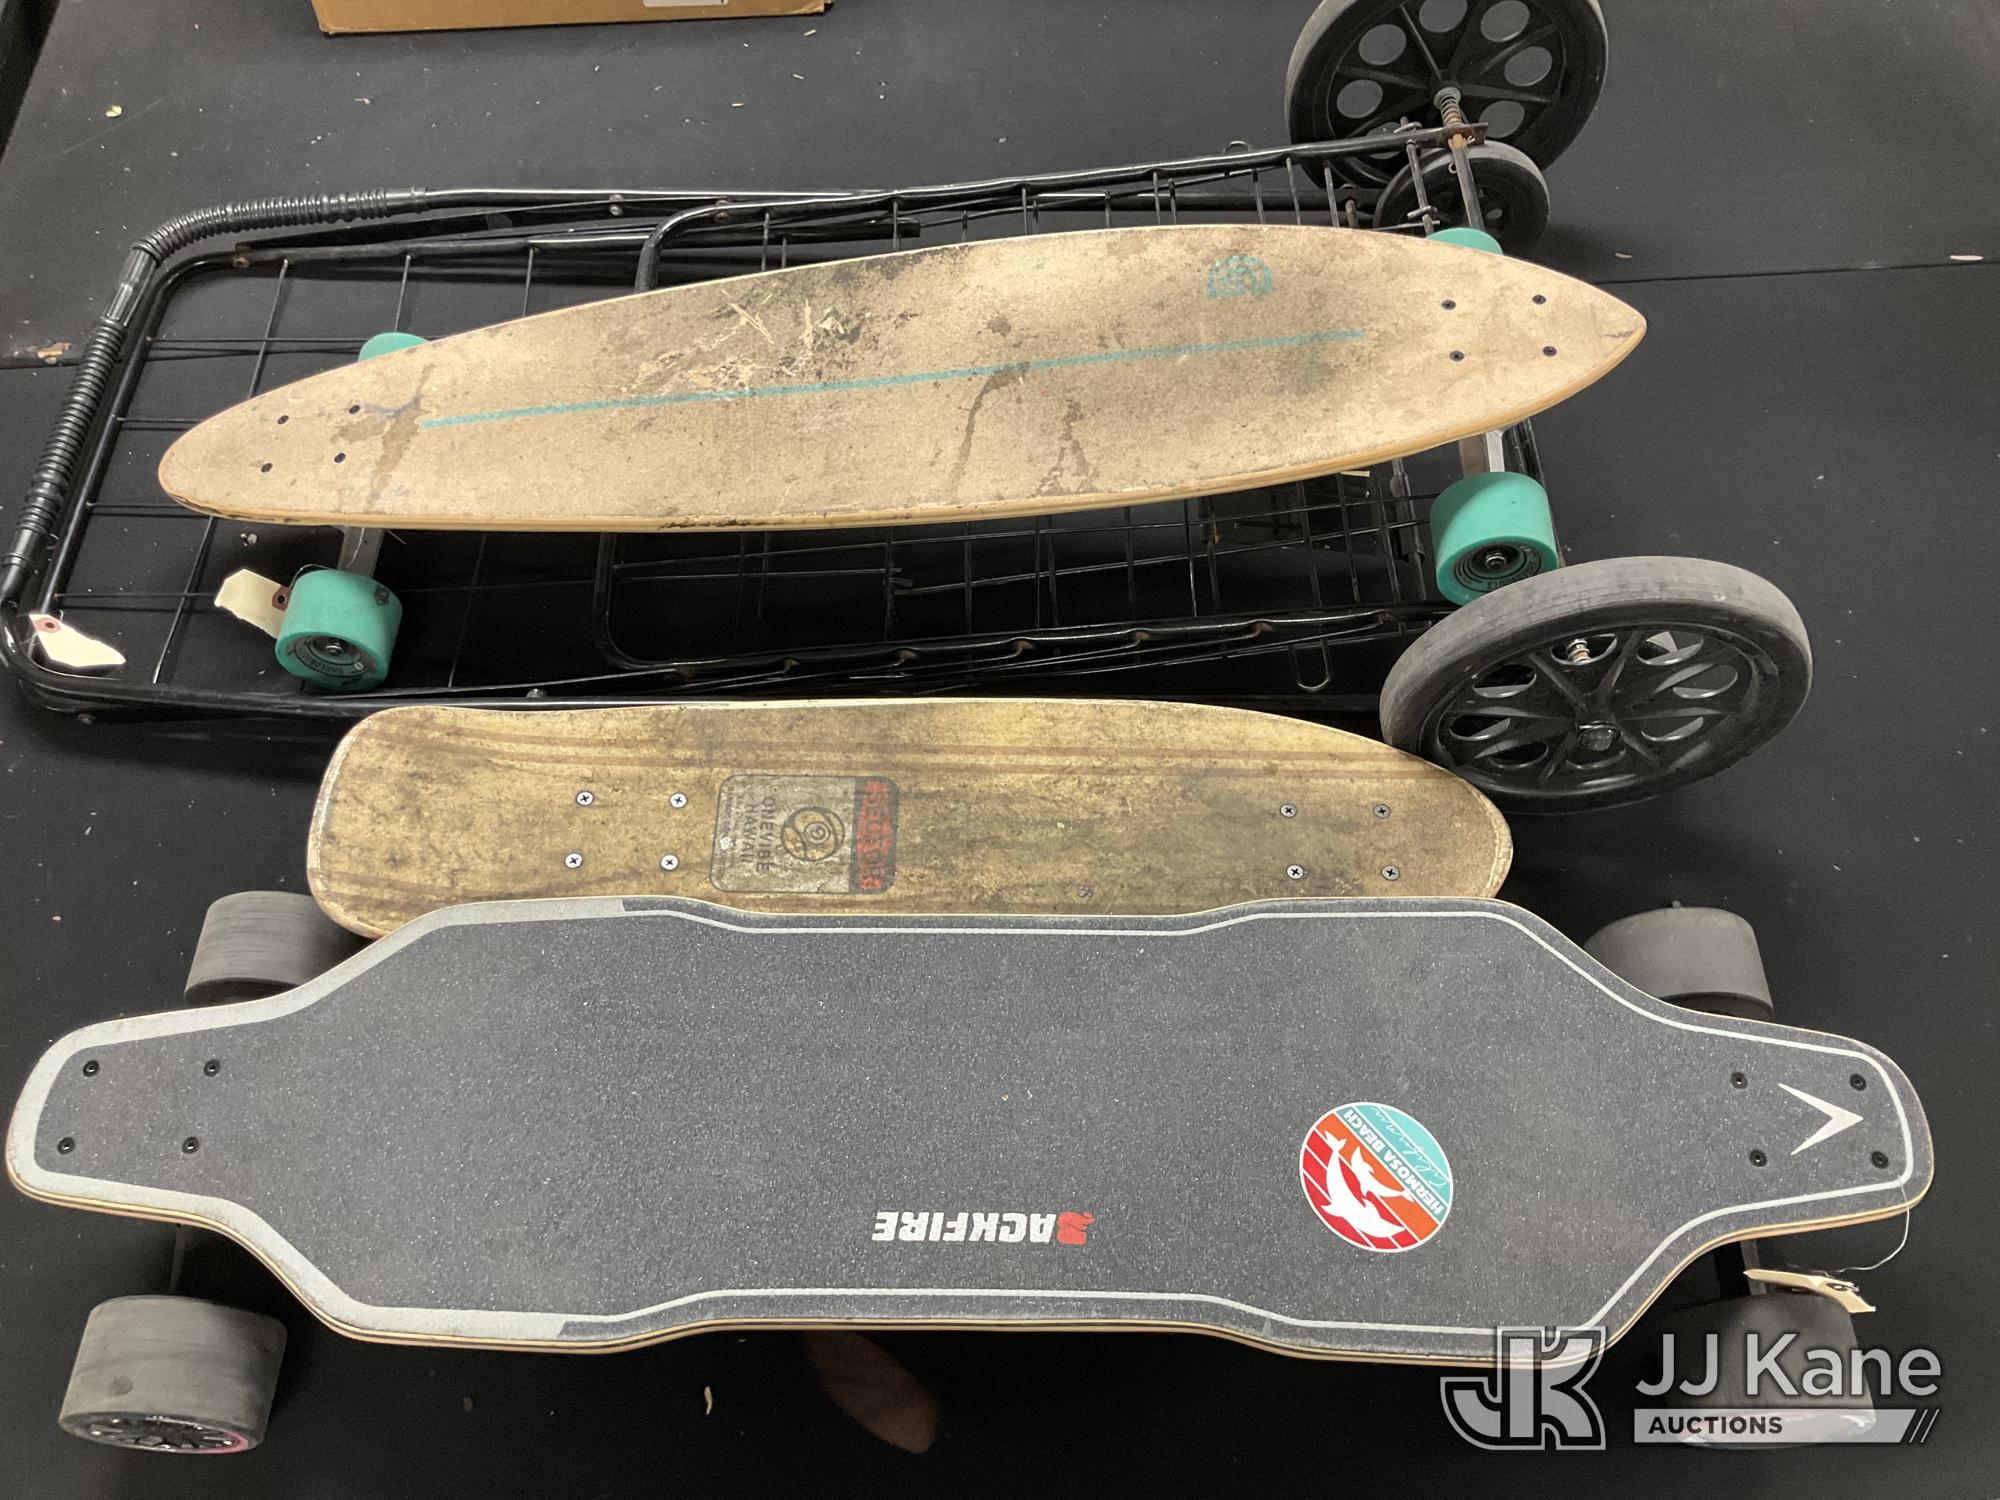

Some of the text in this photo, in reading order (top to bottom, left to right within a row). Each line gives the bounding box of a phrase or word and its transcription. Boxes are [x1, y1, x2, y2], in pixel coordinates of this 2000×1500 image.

[740, 802, 759, 863] HAWAII
[756, 796, 776, 873] ONEVIBE
[1343, 1109, 1445, 1215] HERMOSA BEACH
